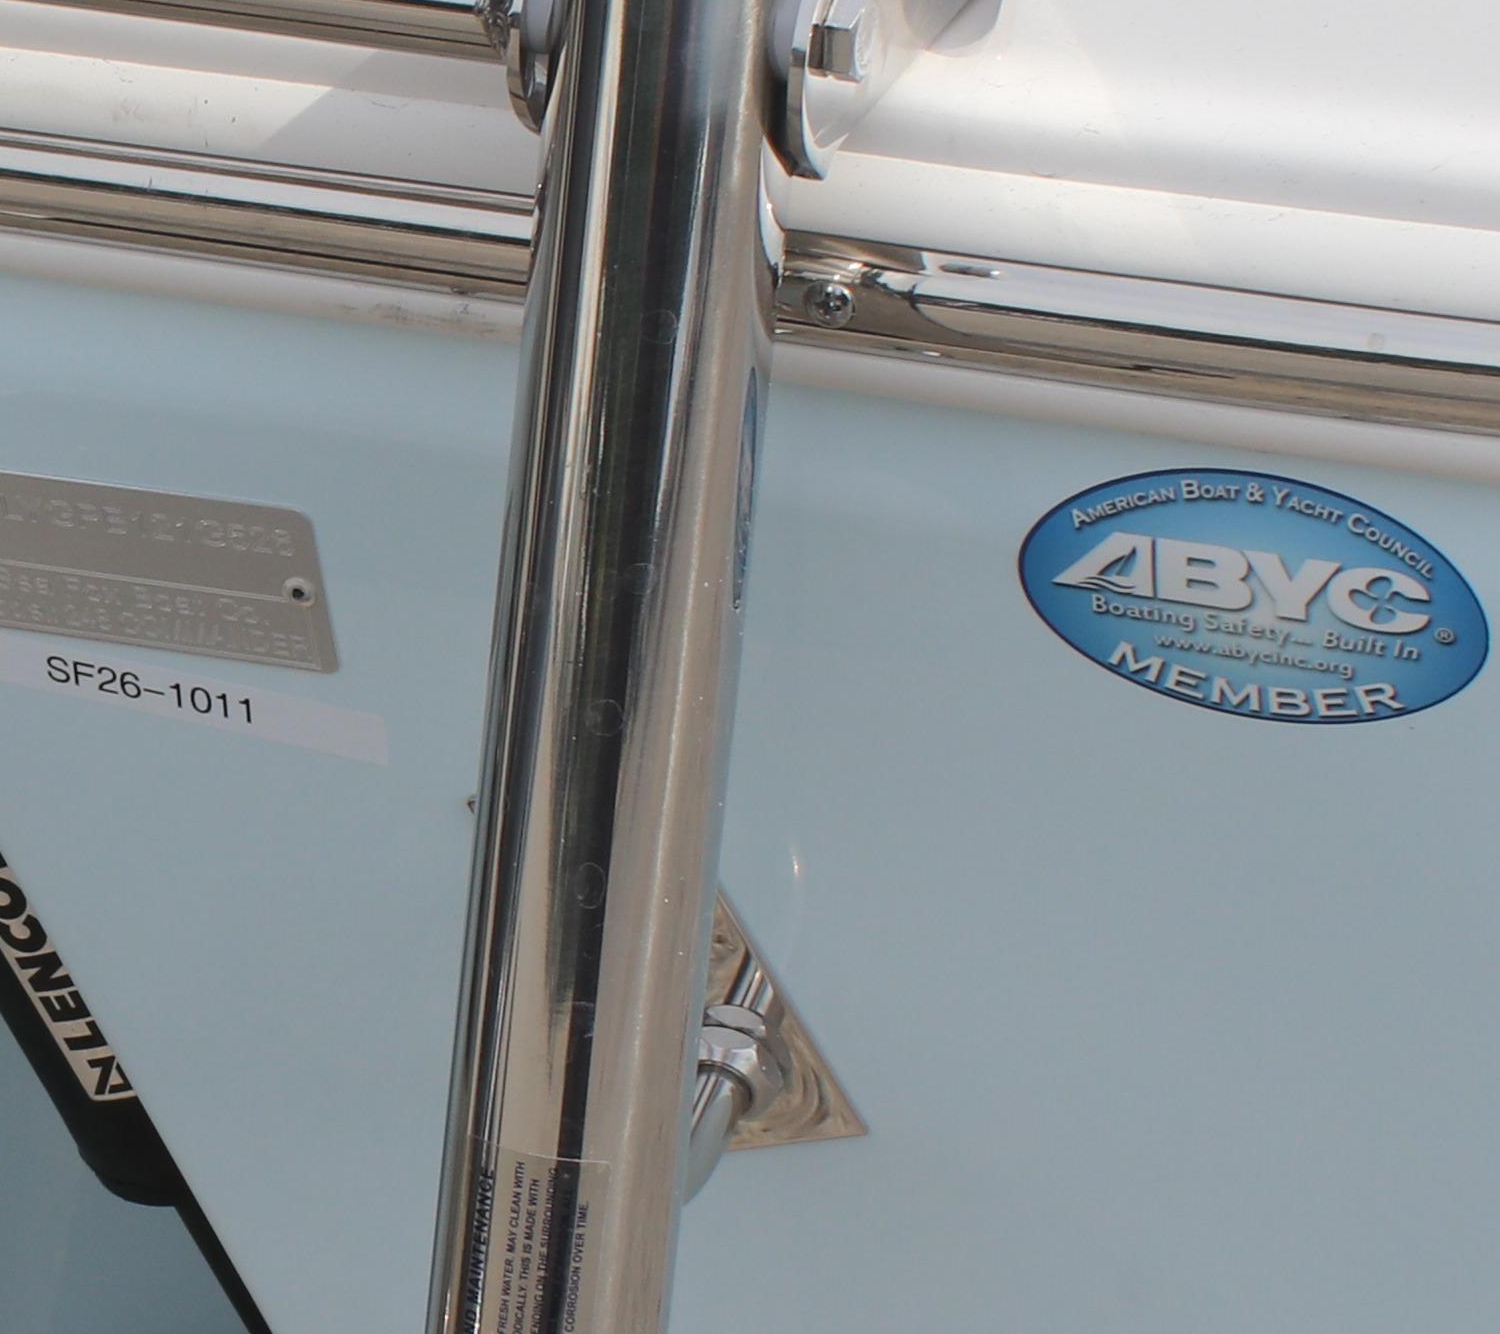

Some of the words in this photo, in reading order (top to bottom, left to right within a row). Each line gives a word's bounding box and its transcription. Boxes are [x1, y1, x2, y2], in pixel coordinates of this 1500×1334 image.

[1245, 481, 1265, 503] &
[1052, 531, 1432, 634] ABYC
[1091, 594, 1196, 632] Boating
[1323, 631, 1385, 656] Built
[1393, 640, 1420, 660] In
[1153, 634, 1354, 679] www.abycinc.org
[46, 655, 255, 724] SF26-1011
[1107, 640, 1406, 717] MEMBER
[514, 1161, 525, 1189] WITH
[528, 1178, 539, 1206] WITH
[541, 1166, 558, 1247] SURROUNDING
[510, 1190, 522, 1228] CLEAN
[524, 1208, 536, 1240] MADE
[576, 1199, 588, 1229] TIME.
[469, 1166, 495, 1303] MAINTENANCE
[507, 1226, 518, 1254] MAY
[523, 1242, 532, 1254] IS
[572, 1232, 584, 1263] OVER
[520, 1256, 530, 1280] THIS
[538, 1250, 548, 1271] THE
[536, 1274, 545, 1291] ON
[564, 1265, 580, 1332] CORROSION
